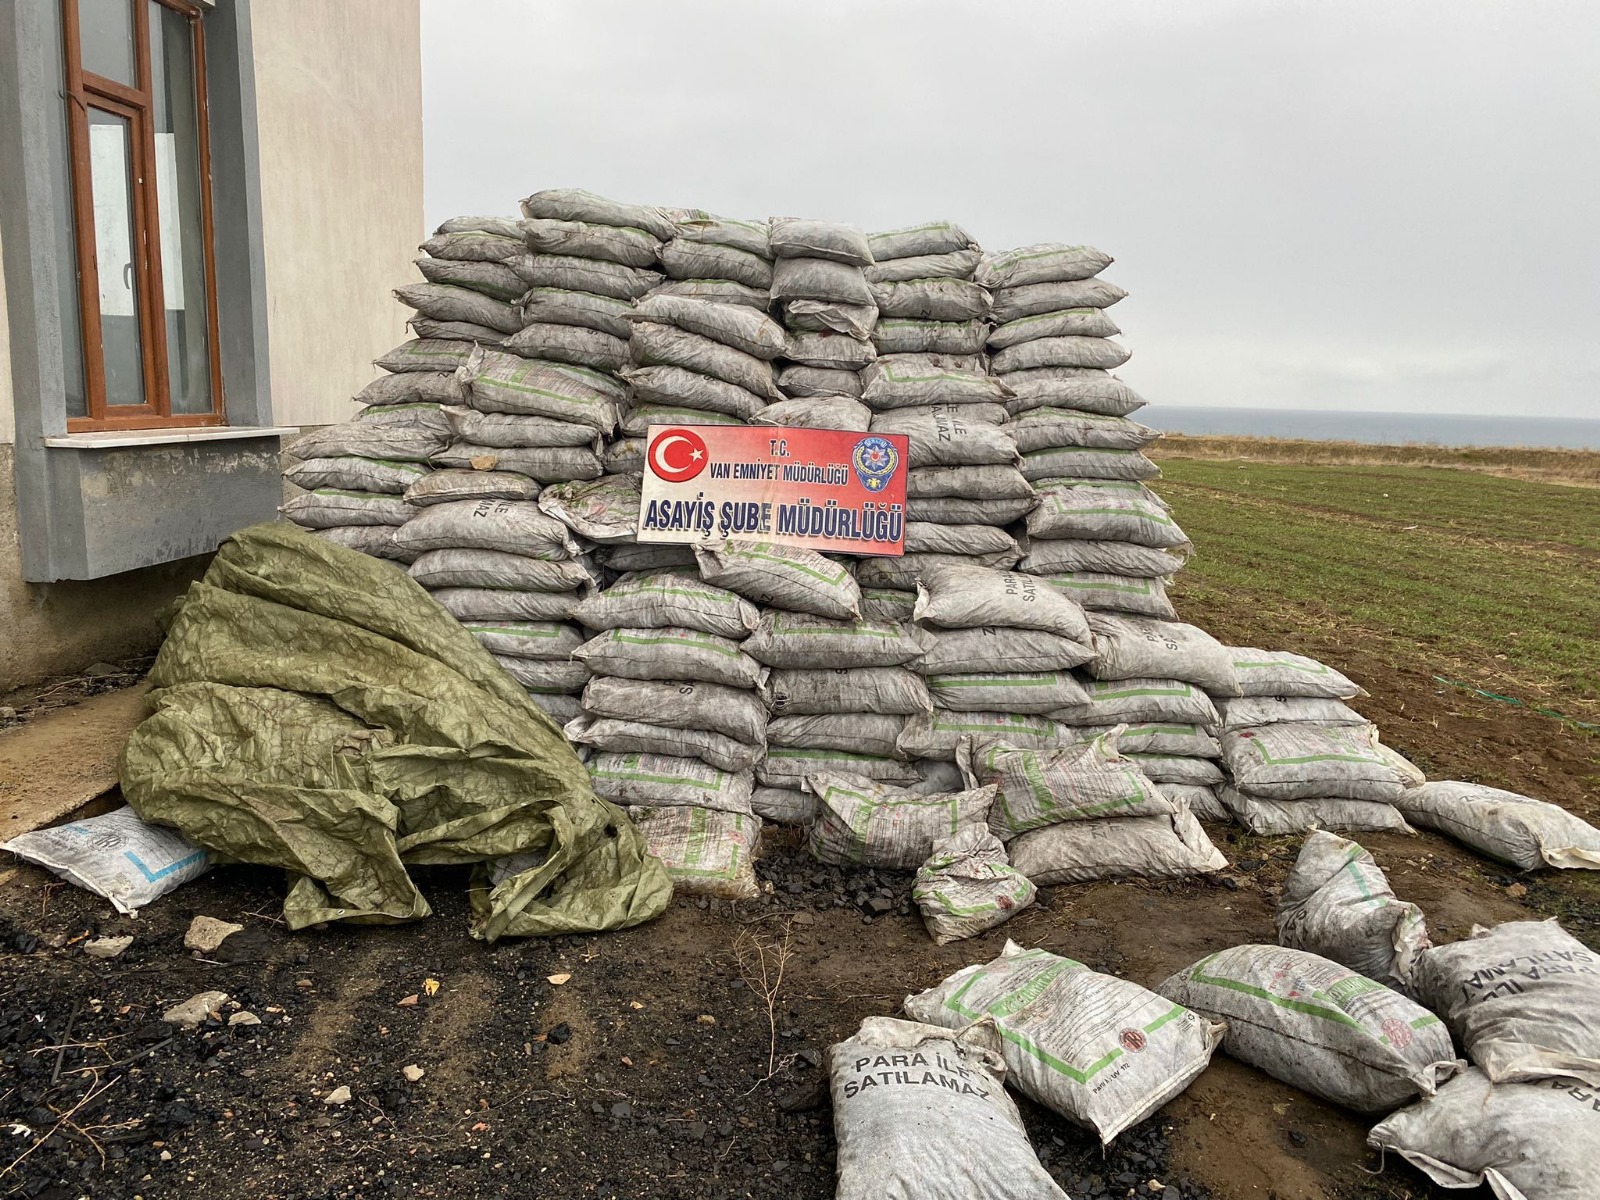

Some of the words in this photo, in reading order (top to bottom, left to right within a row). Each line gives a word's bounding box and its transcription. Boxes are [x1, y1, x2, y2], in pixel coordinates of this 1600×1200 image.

[769, 439, 790, 457] T.C.
[710, 462, 730, 479] VAN
[733, 458, 781, 481] EMNİYET
[782, 461, 849, 486] MÜDÜRLÜĞÜ
[644, 492, 714, 537] ASAYİŞ
[720, 500, 772, 538] ŞUBE
[778, 497, 902, 542] MÜDÜRLÜĞÜ
[856, 1052, 930, 1073] PARA
[936, 1051, 976, 1082] İLE
[844, 1071, 990, 1101] SATILAMAZ
